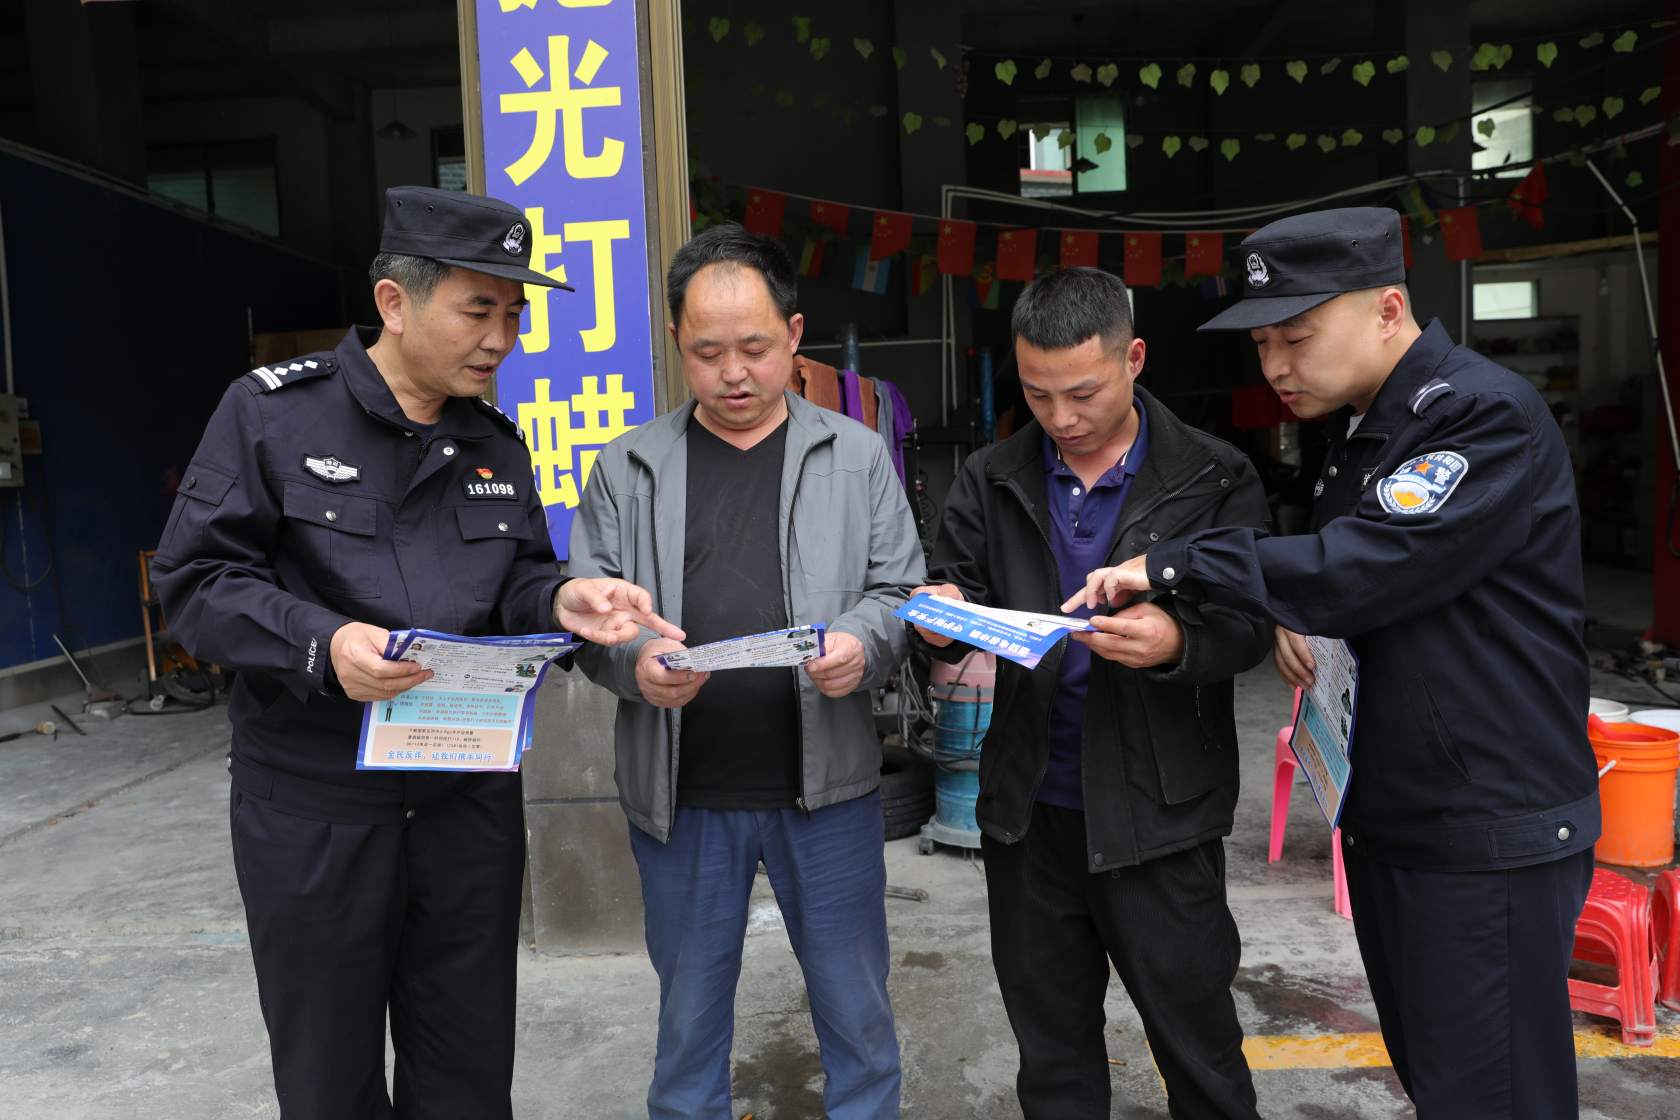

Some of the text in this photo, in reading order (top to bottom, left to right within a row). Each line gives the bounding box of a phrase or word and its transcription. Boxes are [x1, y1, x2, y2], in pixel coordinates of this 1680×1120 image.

[499, 0, 638, 510] 光打蜡
[467, 483, 514, 496] 161098
[306, 637, 318, 673] POLICE
